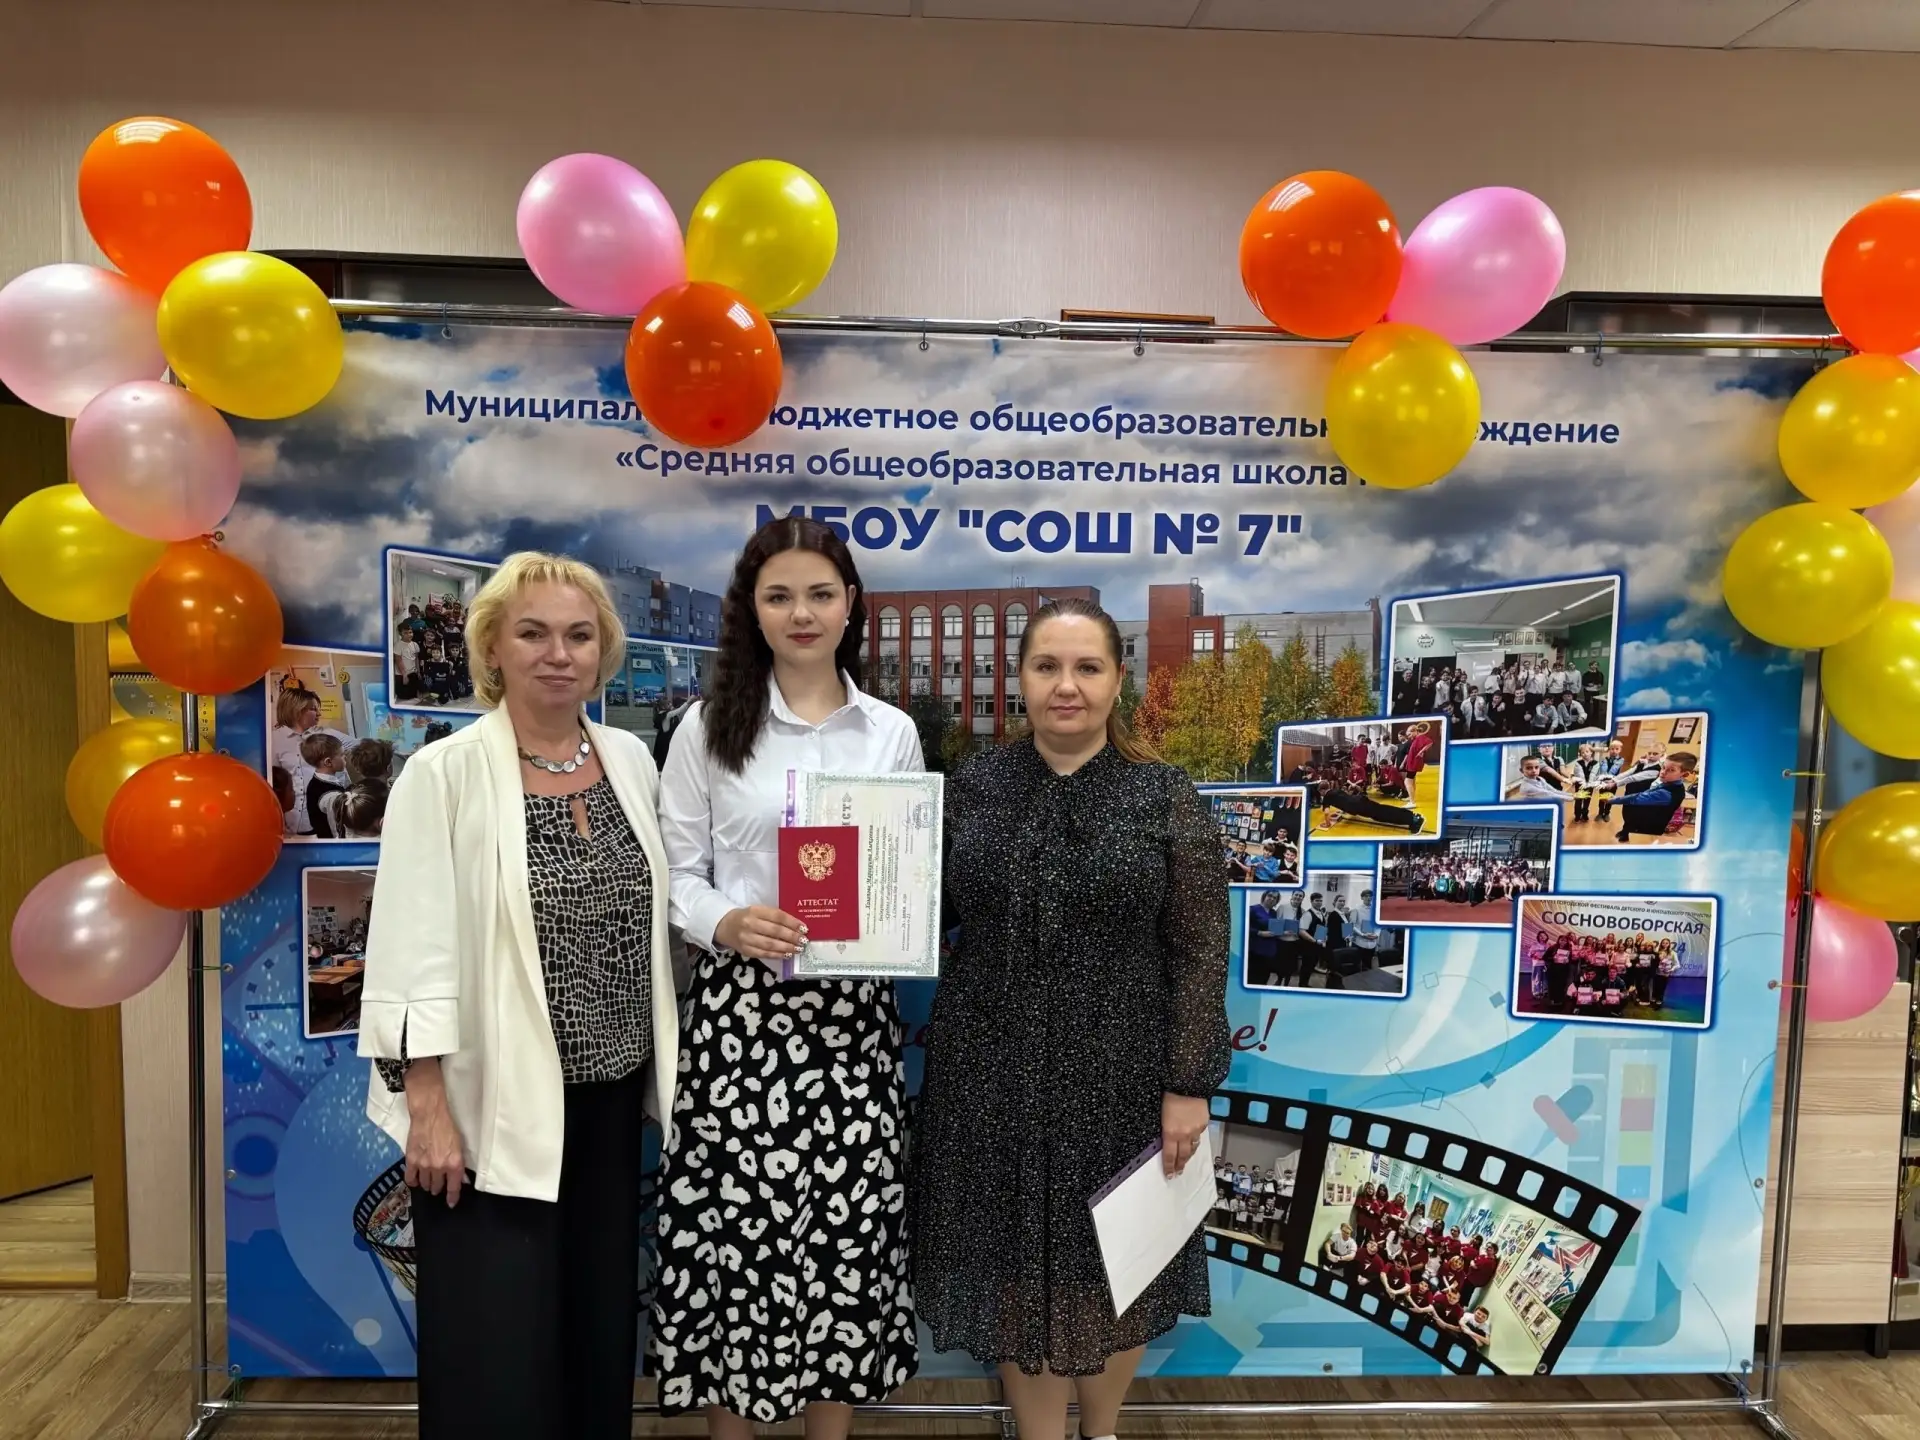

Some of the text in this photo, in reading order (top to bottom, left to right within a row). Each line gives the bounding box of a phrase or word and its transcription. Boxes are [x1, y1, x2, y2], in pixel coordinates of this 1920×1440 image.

[425, 389, 1620, 446] Муниципал юджетное общеобразователь ждение
[615, 443, 1347, 486] «Средняя общеобразовательная школа
[958, 509, 1132, 554] "СОШ
[1153, 512, 1220, 555] №
[1238, 513, 1302, 556] 7"
[841, 803, 851, 828] СТ
[797, 898, 839, 907] АТТЕСТАТ
[1541, 911, 1704, 935] СОСНОВОБОРСКАЯ
